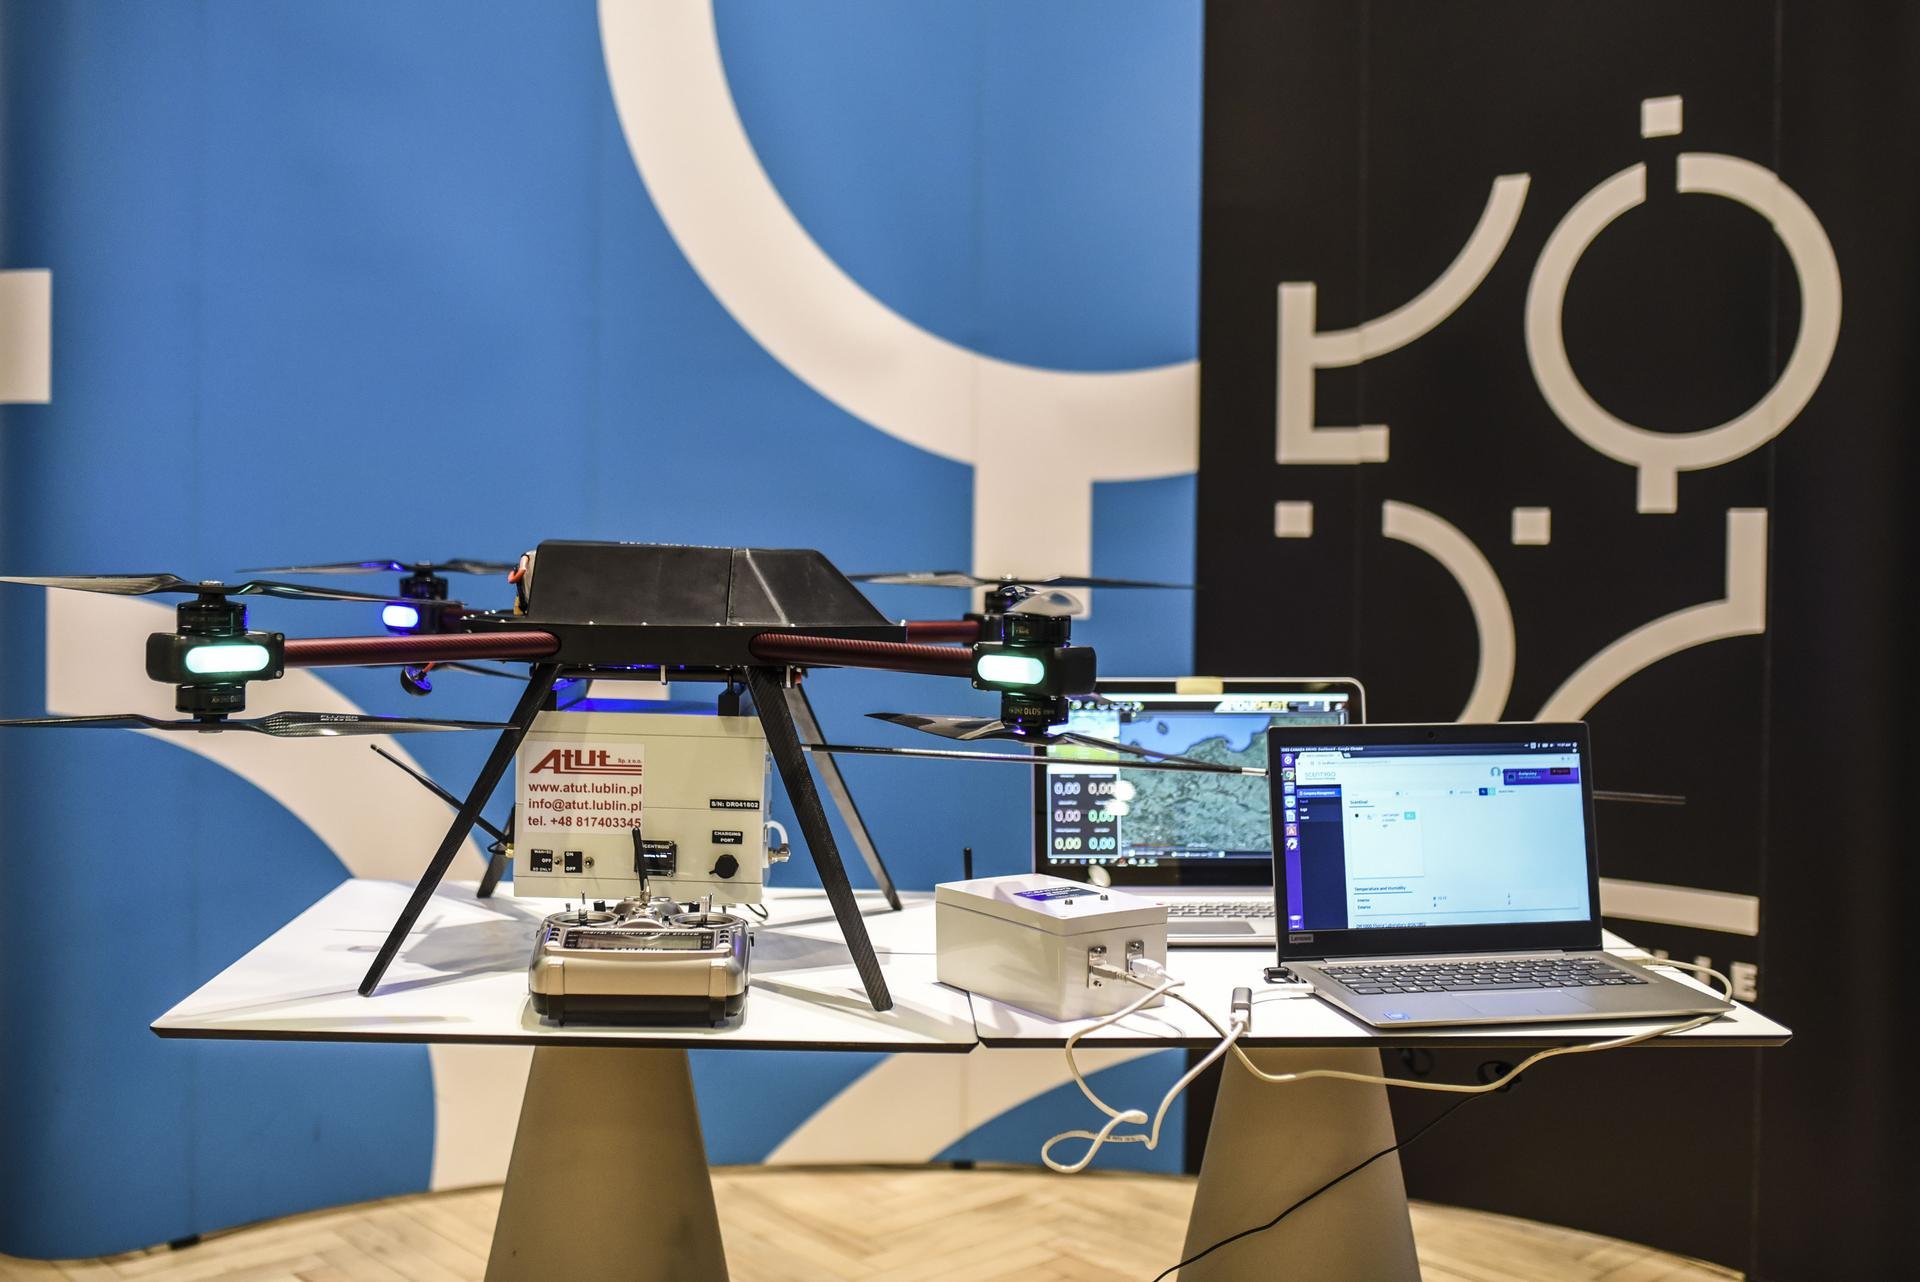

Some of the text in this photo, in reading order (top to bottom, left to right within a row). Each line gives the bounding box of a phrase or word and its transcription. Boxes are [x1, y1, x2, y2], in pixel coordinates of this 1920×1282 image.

[528, 783, 642, 797] www.atut.lublin.pl
[1054, 782, 1081, 796] 0,00
[528, 798, 642, 813] info@atut.lublin.pl
[528, 816, 641, 828] tel. +48 817403345
[1054, 809, 1081, 823] 0,00
[1054, 837, 1081, 851] 0,00
[1088, 837, 1116, 851] 0,00
